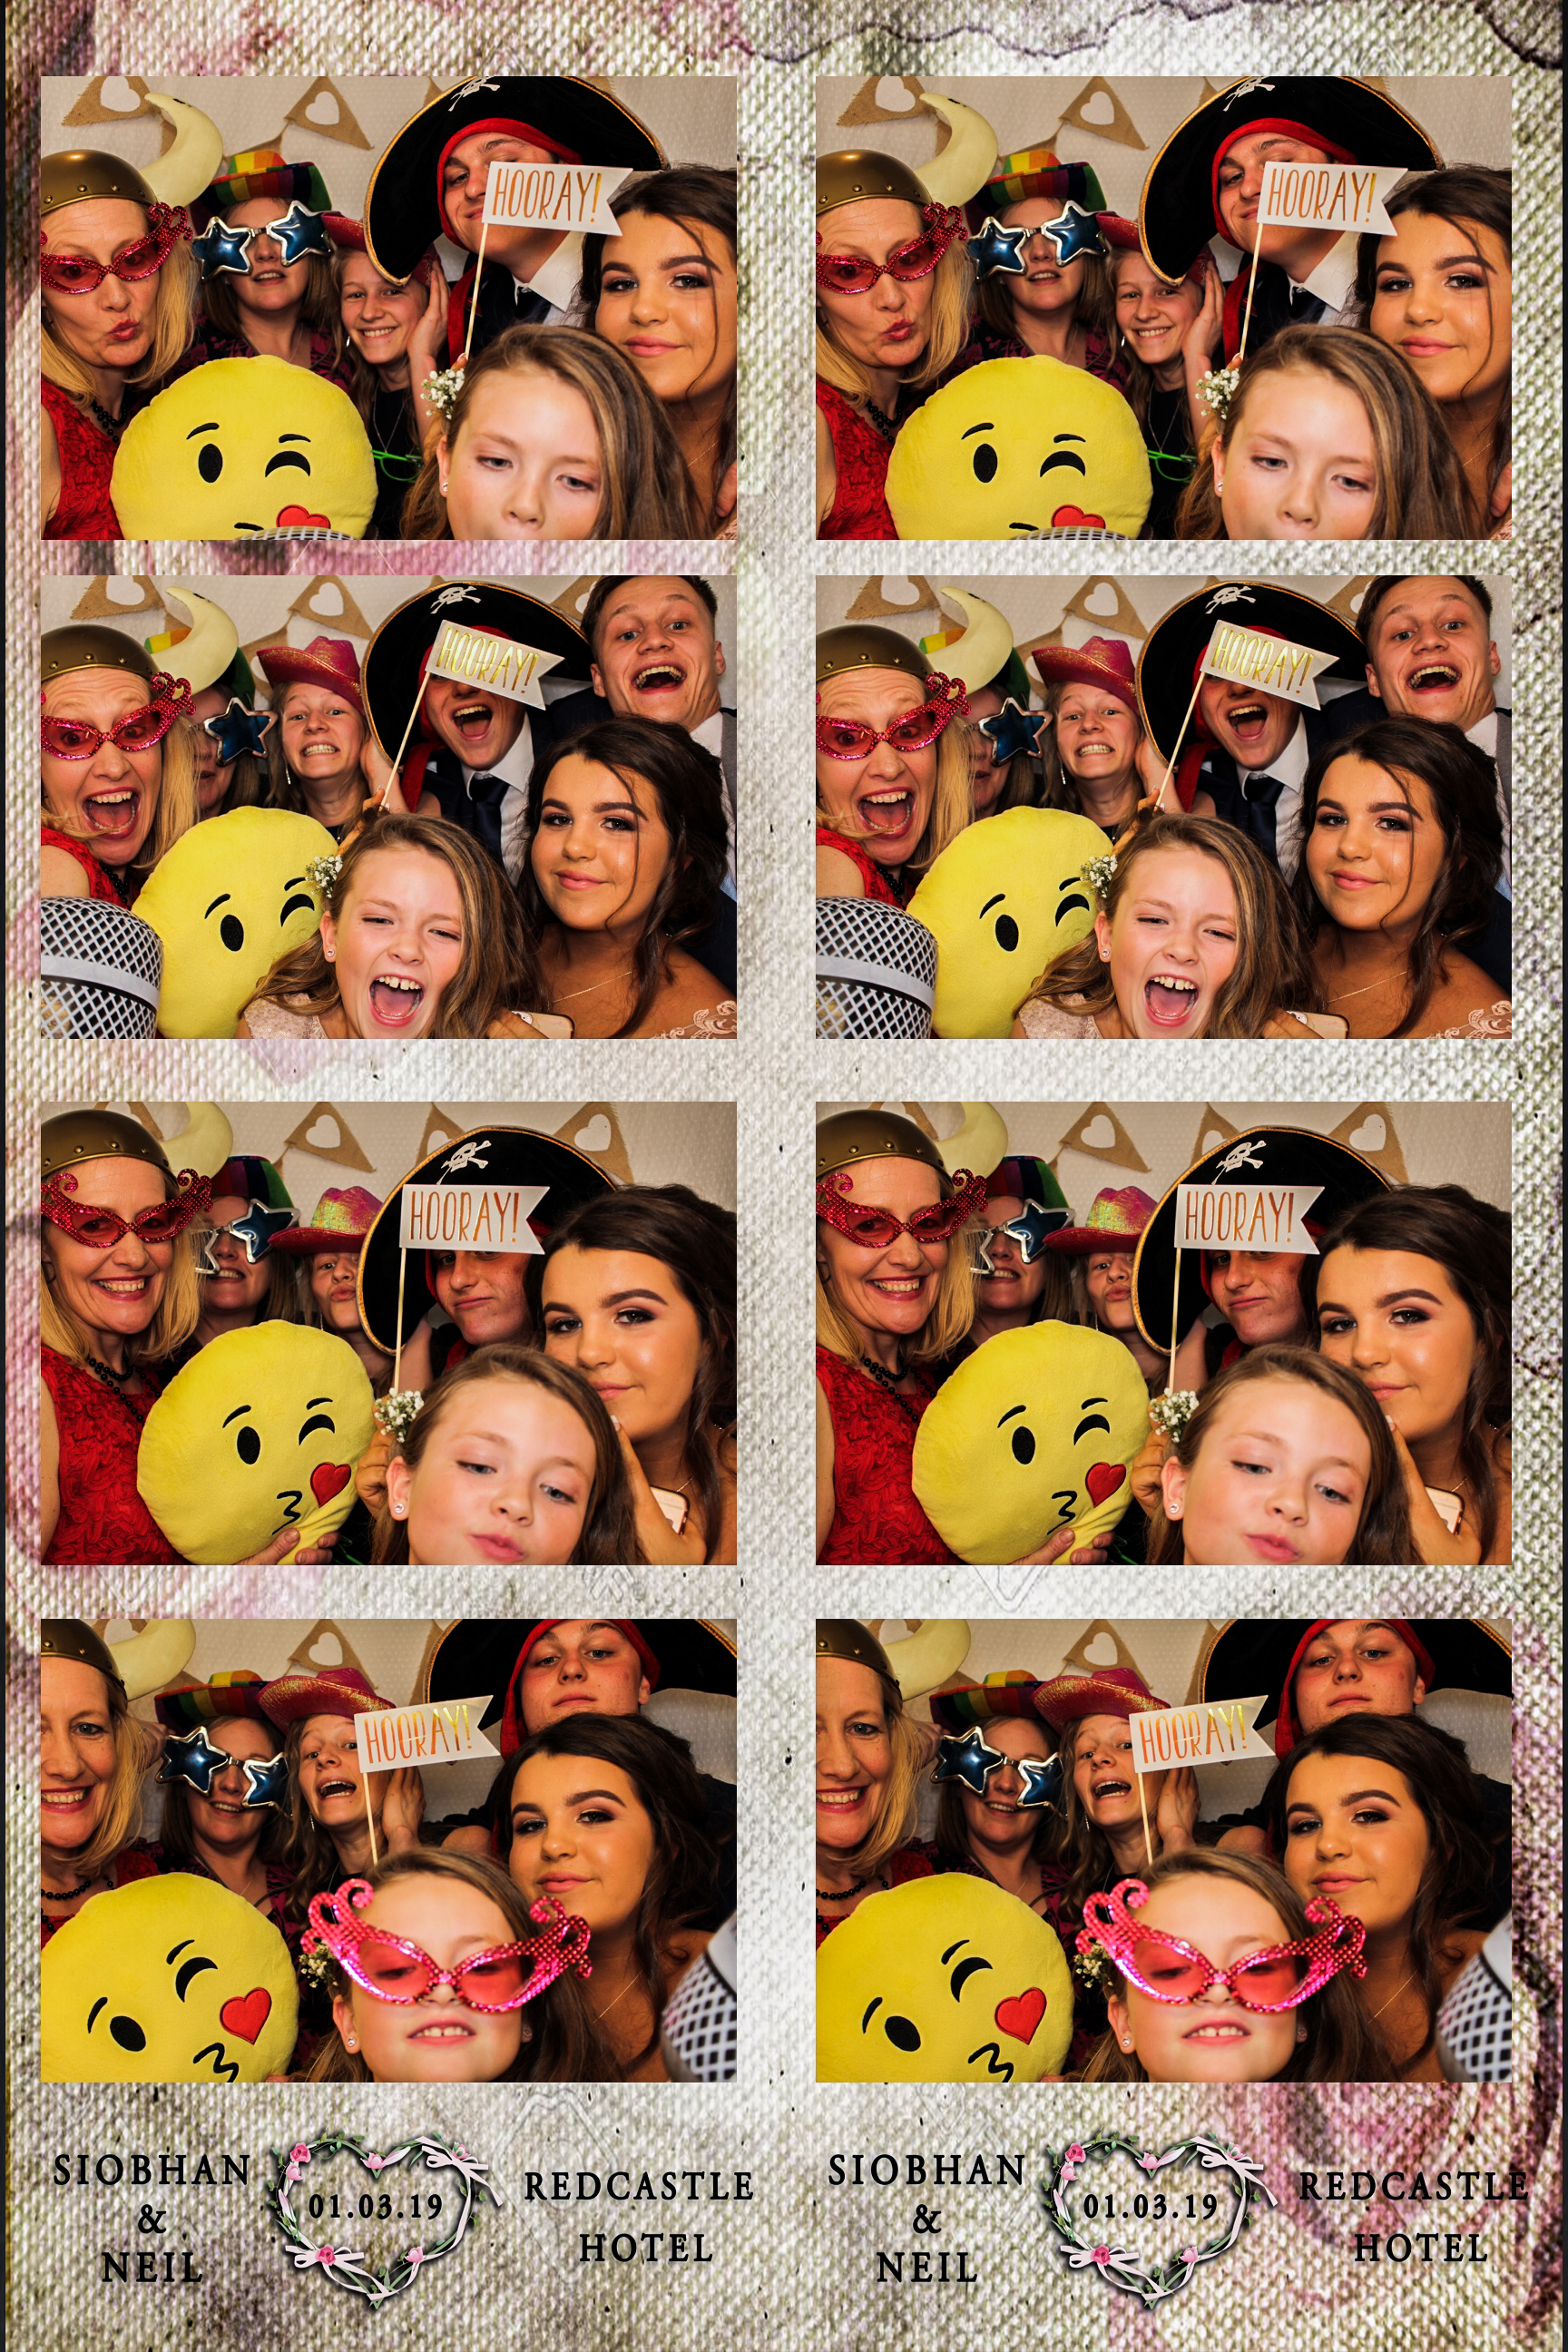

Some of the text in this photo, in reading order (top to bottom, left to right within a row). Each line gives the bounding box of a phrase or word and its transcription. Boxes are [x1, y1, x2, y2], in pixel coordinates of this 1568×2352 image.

[492, 168, 602, 222] HOORAY!
[1267, 168, 1377, 222] HOORAY!
[436, 627, 538, 694] HOORAY!
[1210, 627, 1313, 694] HOORAY!
[410, 1191, 519, 1243] HOORAY!
[1185, 1191, 1294, 1243] HOORAY!
[364, 1704, 471, 1764] HOORAY!
[1139, 1704, 1246, 1764] HOORAY!
